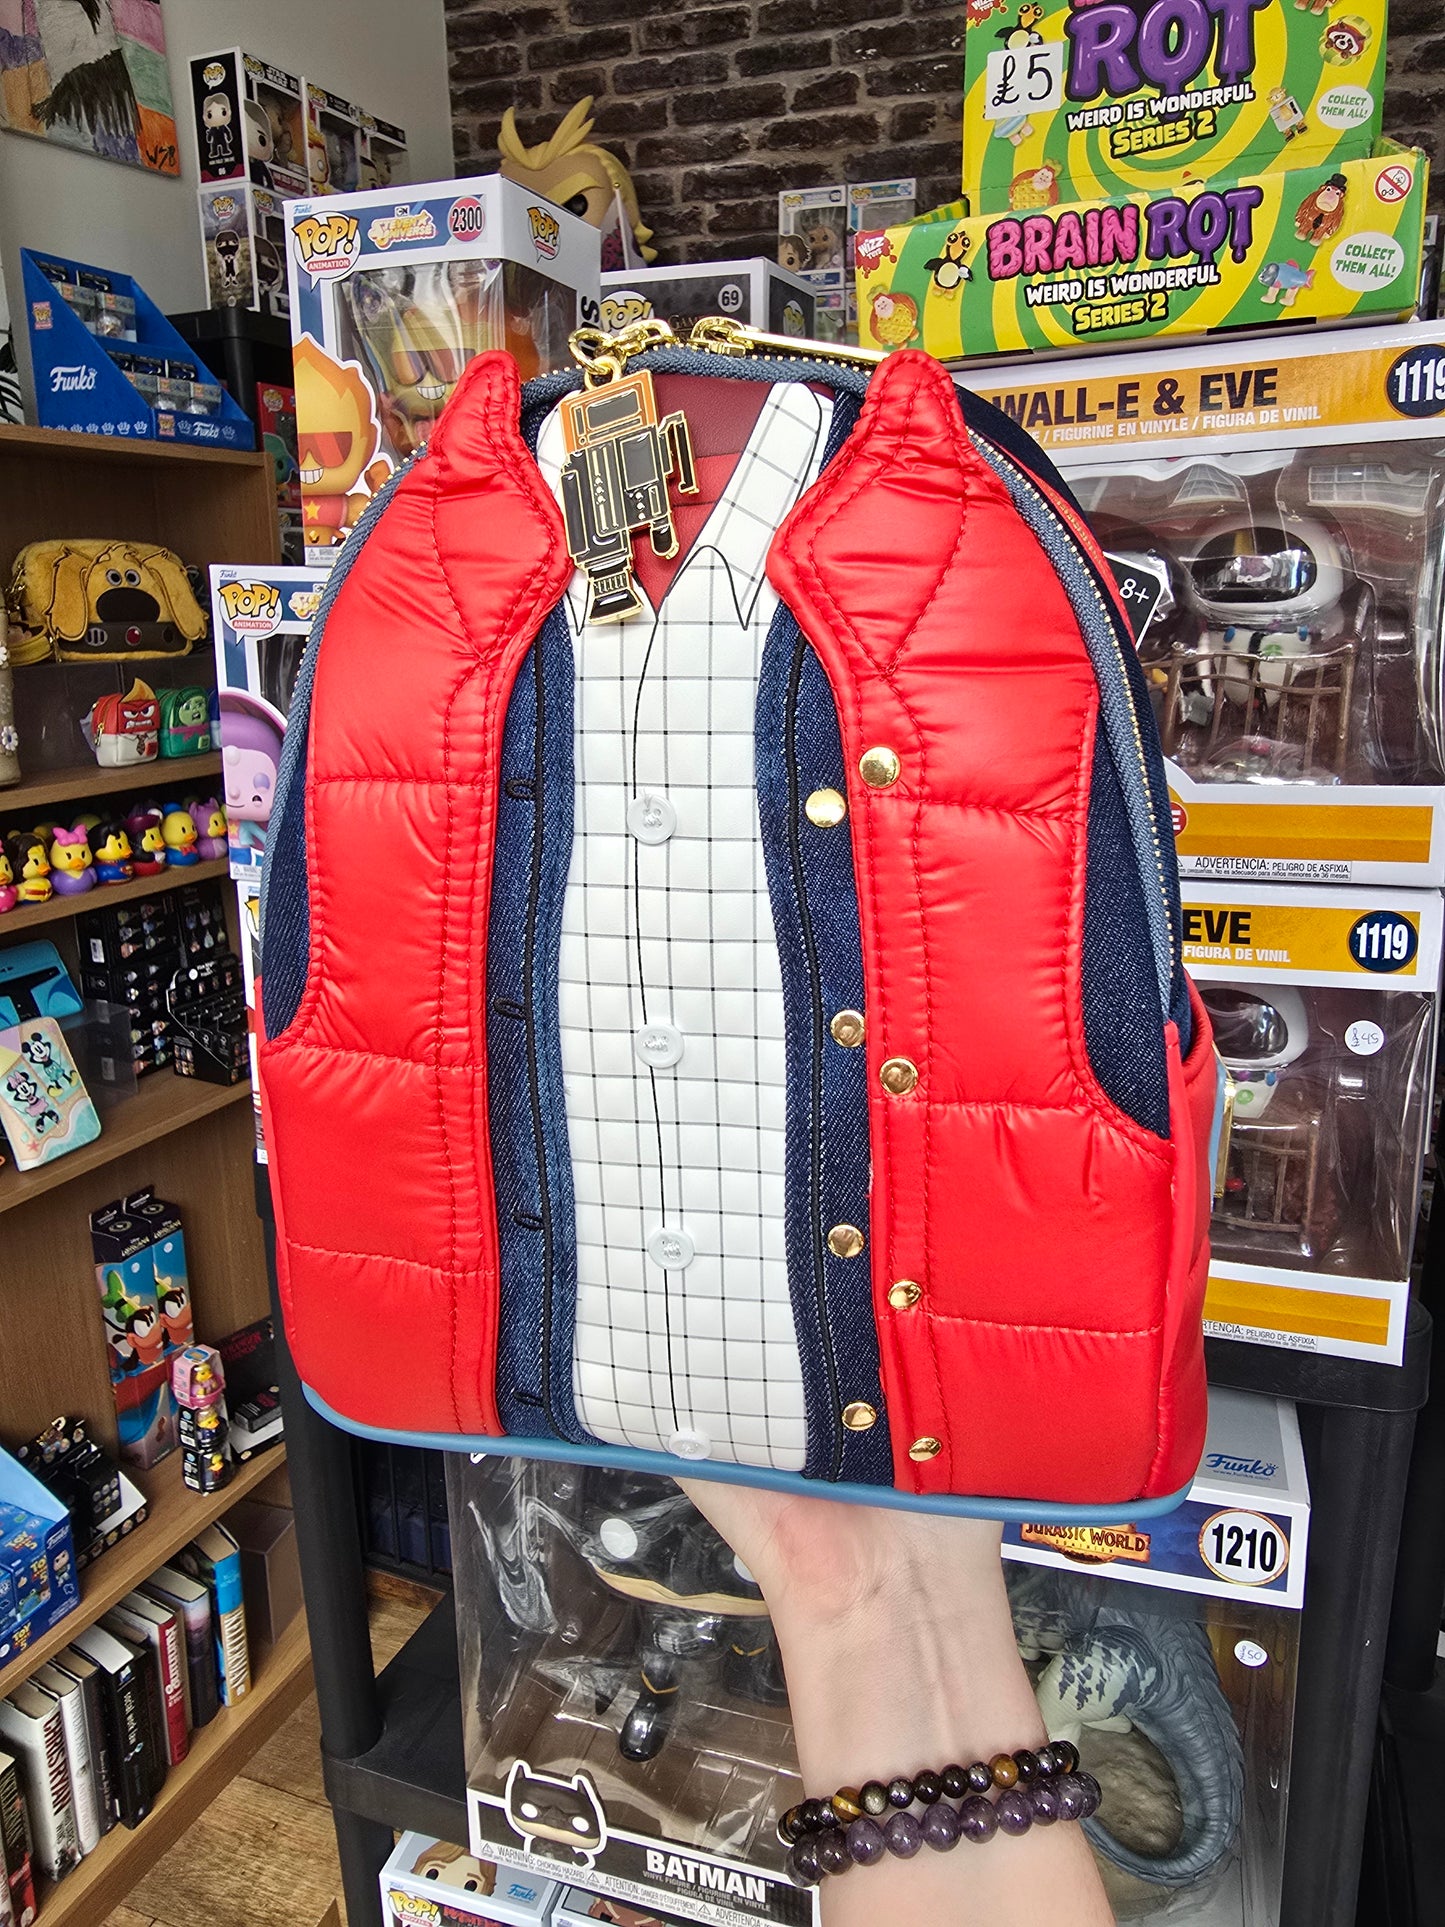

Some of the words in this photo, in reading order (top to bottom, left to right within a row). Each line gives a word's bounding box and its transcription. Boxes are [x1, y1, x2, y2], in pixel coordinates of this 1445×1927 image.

[1067, 0, 1268, 100] ROT
[992, 53, 1053, 107] £5
[1068, 108, 1122, 130] WEIRD
[1127, 102, 1146, 121] IS
[1150, 83, 1254, 116] WONDERFUL
[1320, 106, 1346, 117] THEM
[1347, 107, 1368, 119] ALL!
[1327, 94, 1367, 106] COLLECT
[1113, 119, 1190, 156] SERIES
[1194, 111, 1214, 138] 2
[452, 206, 483, 232] 2300
[527, 206, 560, 247] POP!
[988, 206, 1138, 279] BRAIN
[1146, 187, 1262, 264] ROT
[291, 216, 360, 262] POP!
[1344, 244, 1396, 261] COLLECT
[309, 259, 350, 271] ANIMATION
[1335, 259, 1368, 276] THEM
[1369, 260, 1396, 278] ALL!
[721, 290, 740, 306] 69
[1026, 280, 1082, 305] WEIRD
[1087, 276, 1105, 298] IS
[1111, 264, 1220, 295] WONDERFUL
[1075, 301, 1147, 332] SERIES
[1148, 291, 1168, 318] 2
[49, 364, 98, 393] Funko
[994, 381, 1140, 429] WALL-E
[1152, 377, 1185, 416] &
[1200, 368, 1279, 412] EVE
[1052, 423, 1115, 442] FIGURINE
[1117, 420, 1137, 437] EN
[1140, 415, 1189, 435] VINYLE
[1202, 410, 1256, 431] FIGURA
[1258, 408, 1280, 426] DE
[1282, 404, 1322, 423] VINIL
[218, 582, 281, 620] POP!
[1119, 578, 1150, 604] 8+
[233, 620, 272, 629] ANIMATION
[1195, 856, 1270, 871] ADVERTENCIA:
[1272, 862, 1305, 872] PELIGRO
[1306, 864, 1318, 872] DE
[1318, 864, 1351, 873] ASFIXIA.
[1182, 909, 1252, 945] EVE
[1356, 922, 1409, 961] 1119
[1184, 946, 1232, 960] FIGURA
[1235, 948, 1253, 960] DE
[1255, 949, 1291, 963] VINIL
[1246, 1328, 1276, 1340] PELIGRO
[1277, 1333, 1288, 1341] DE
[1206, 1453, 1279, 1477] Funko
[1025, 1523, 1086, 1542] JURASSIC
[1090, 1528, 1147, 1552] WORLD
[1212, 1523, 1278, 1573] 1210
[12, 1621, 31, 1642] TOY
[43, 1711, 66, 1769] CHRIS
[49, 1762, 71, 1817] RYAN
[497, 1846, 535, 1865] WARNING:
[506, 1883, 538, 1900] Funko
[646, 1849, 766, 1903] BATMAN
[387, 1889, 440, 1922] POP!
